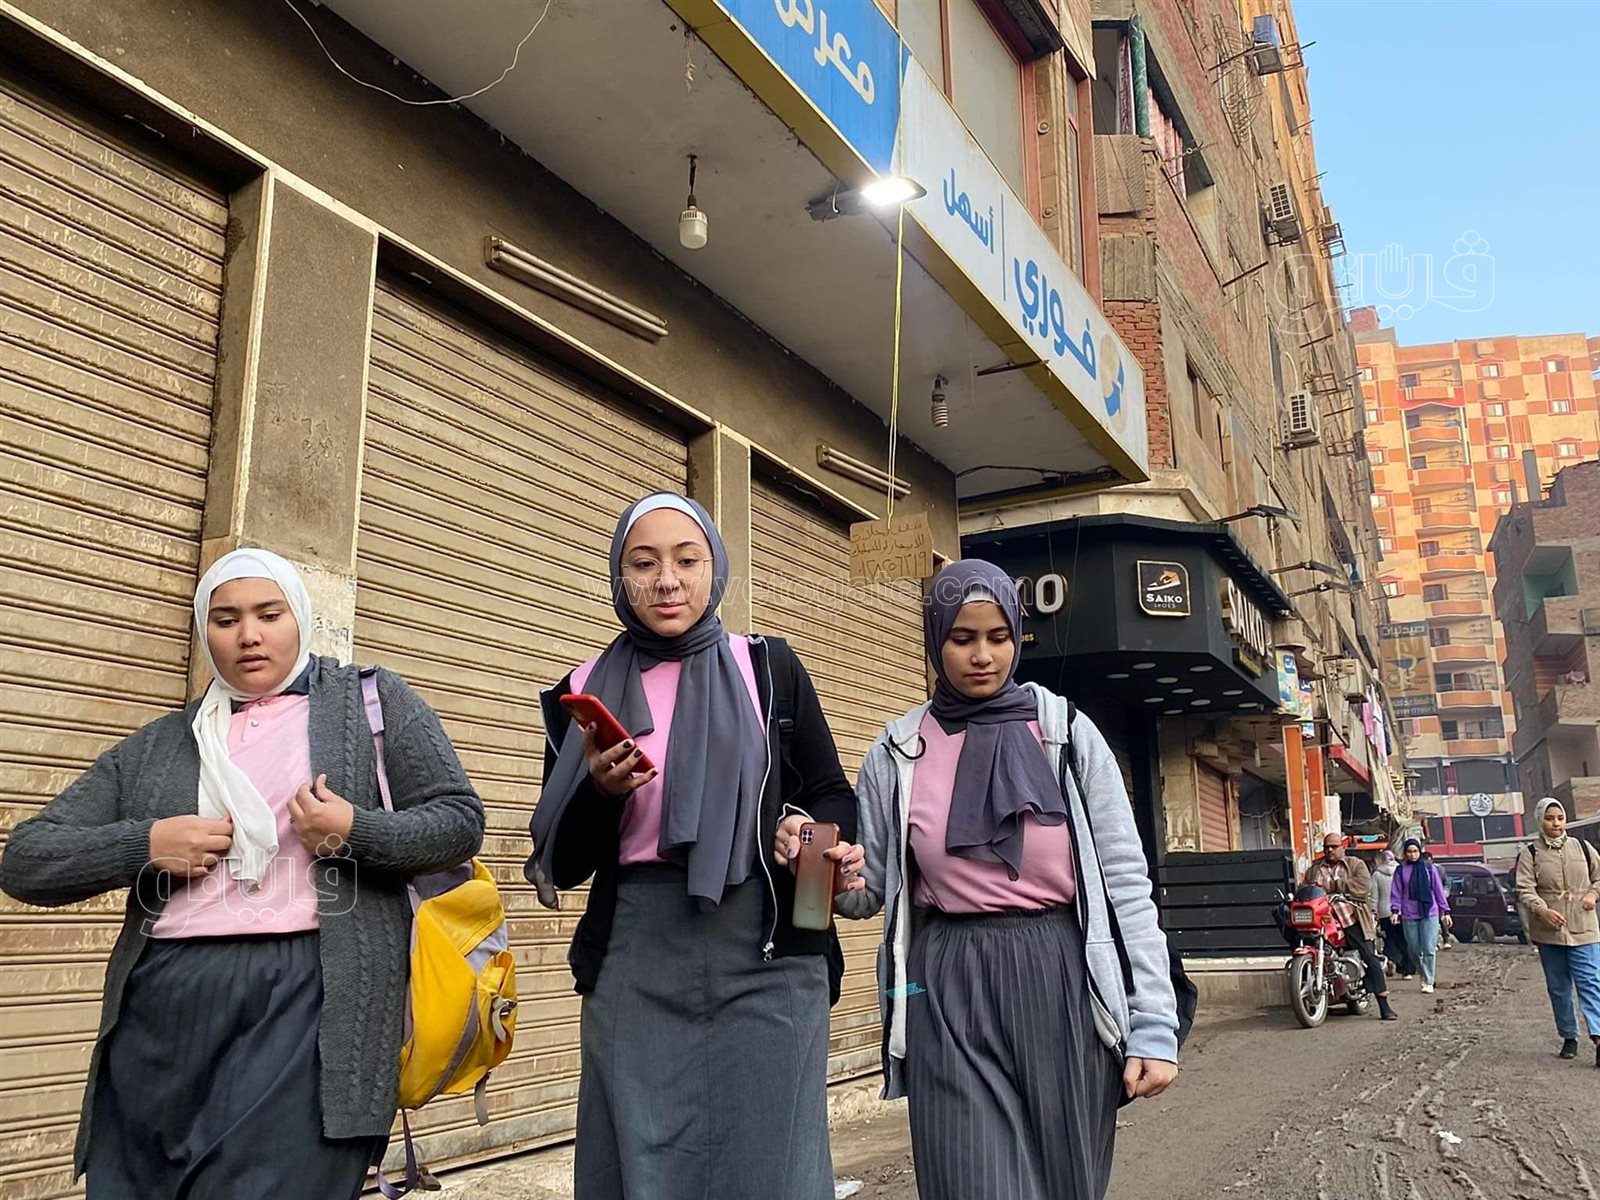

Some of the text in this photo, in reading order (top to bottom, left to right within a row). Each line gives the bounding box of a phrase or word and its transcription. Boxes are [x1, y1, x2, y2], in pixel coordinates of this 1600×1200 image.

[943, 167, 1097, 381] فوري أسهل
[1146, 593, 1183, 604] SAIKO
[1228, 577, 1265, 657] SAIKO
